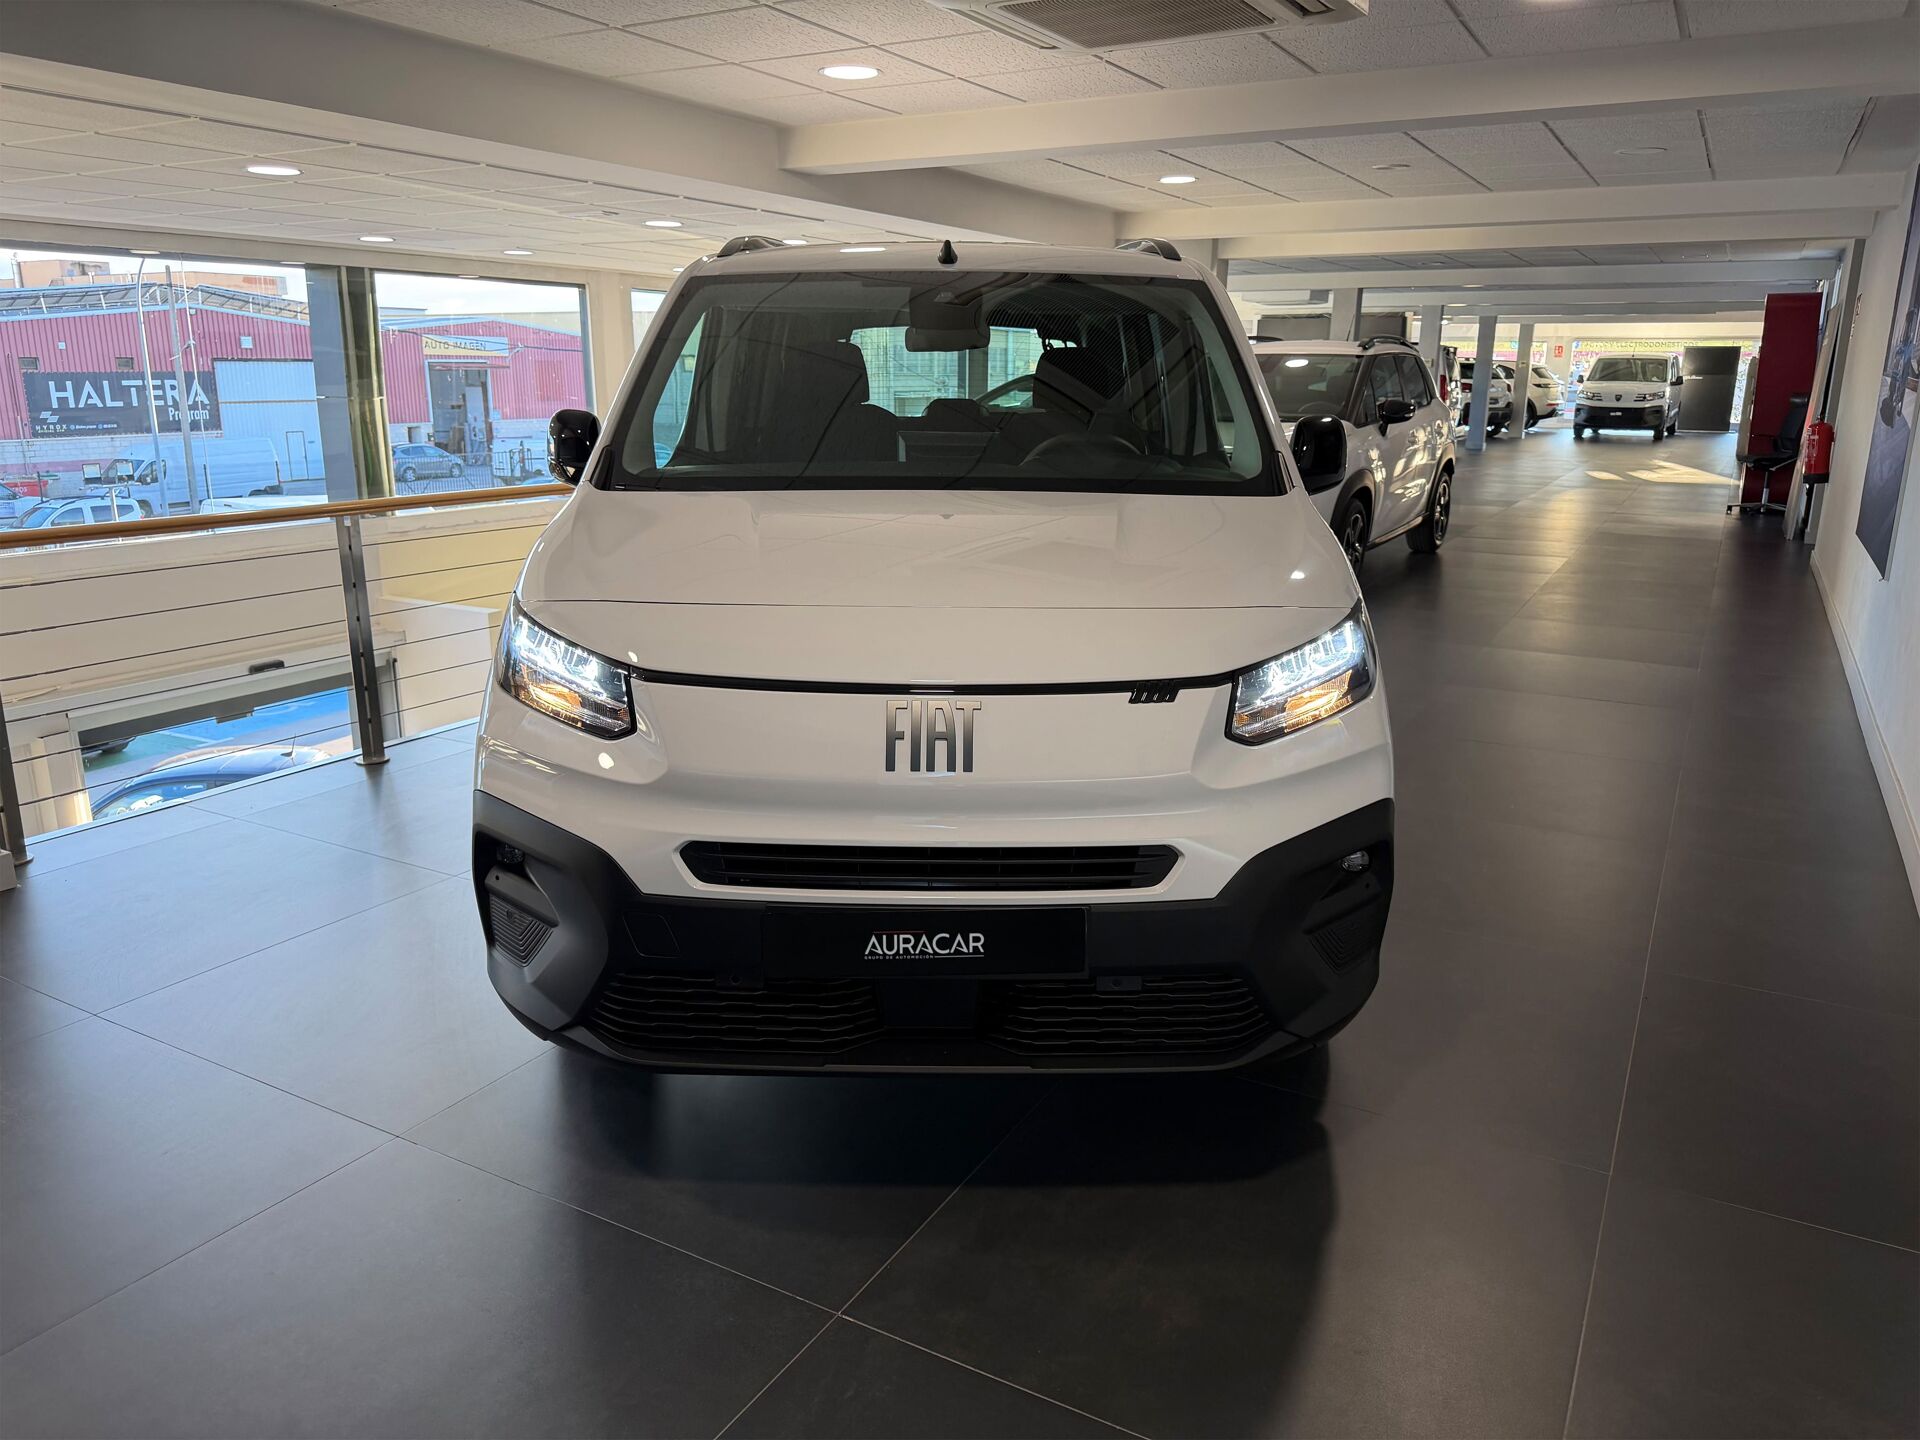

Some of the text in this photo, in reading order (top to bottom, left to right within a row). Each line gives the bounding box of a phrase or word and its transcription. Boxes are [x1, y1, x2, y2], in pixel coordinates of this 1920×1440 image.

[424, 340, 450, 350] AUTO
[49, 379, 210, 408] HALTERA
[168, 407, 210, 423] Prram
[885, 700, 982, 773] FIAT
[864, 932, 985, 955] AURACAR
